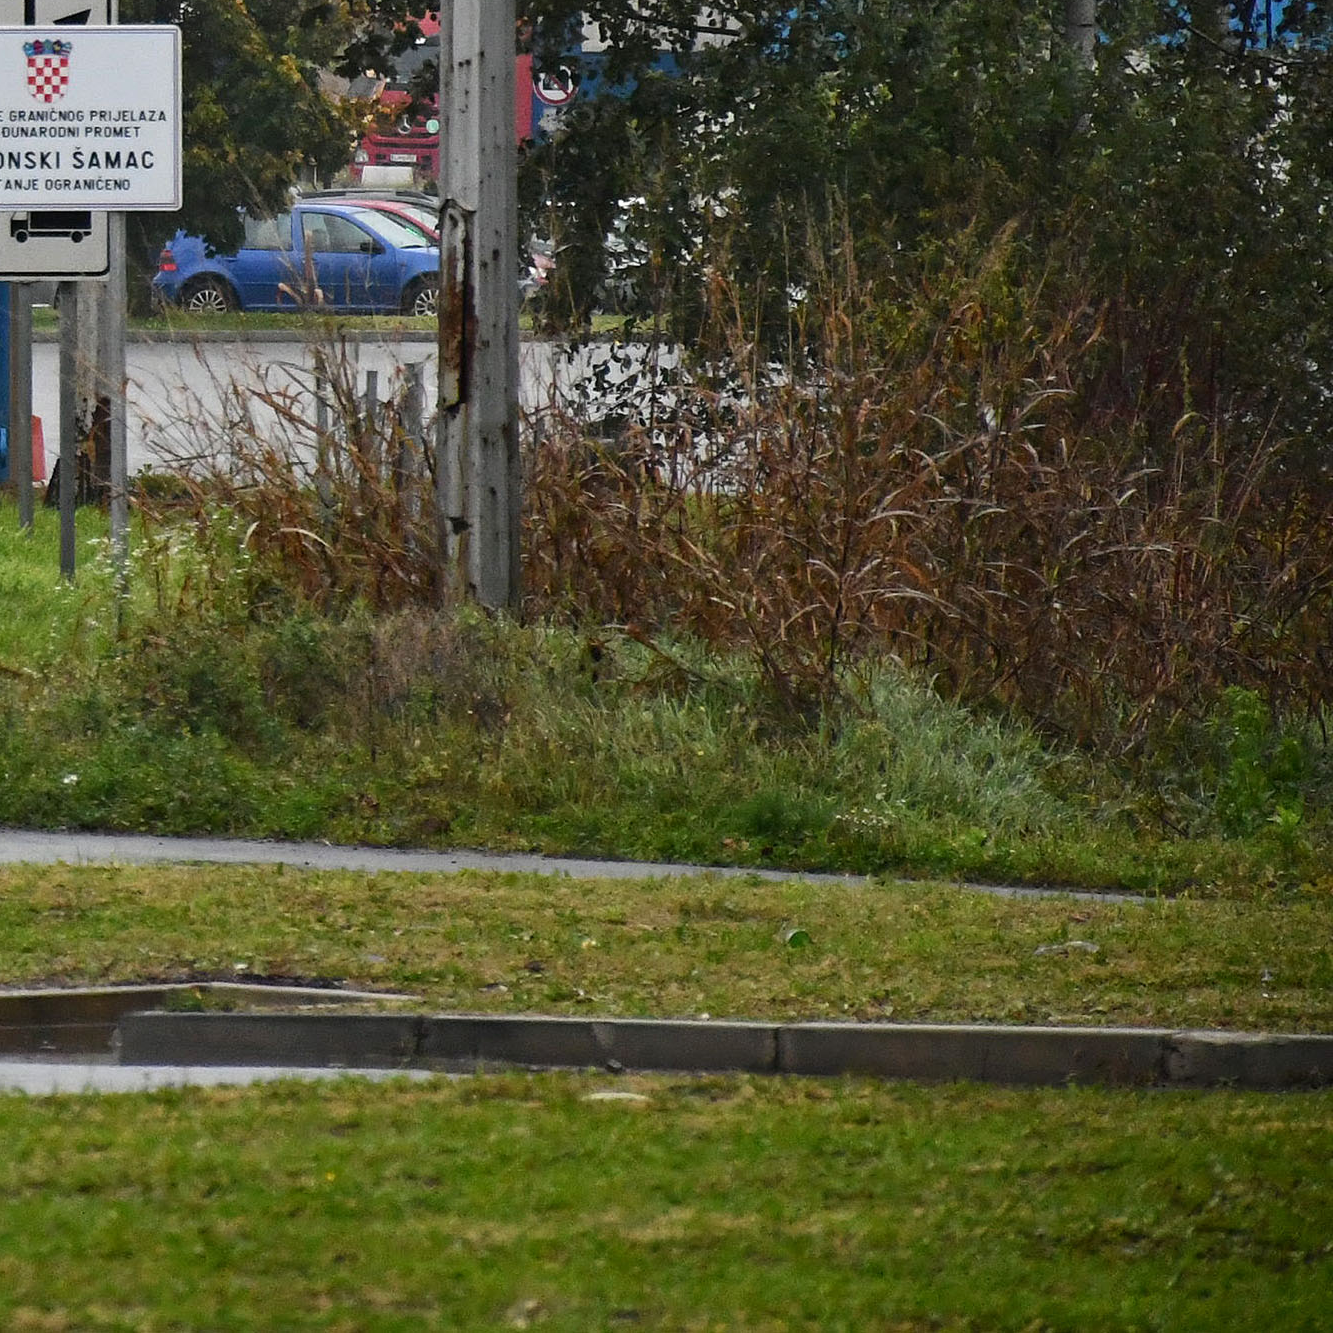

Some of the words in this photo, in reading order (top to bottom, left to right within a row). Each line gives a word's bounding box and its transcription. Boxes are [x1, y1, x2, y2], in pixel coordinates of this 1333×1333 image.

[9, 107, 84, 122] GRANIČNOG
[90, 110, 167, 122] PRIJELAZA
[85, 126, 141, 138] PROMET
[72, 147, 155, 170] ŠAMAC
[45, 176, 131, 191] OGRANIČENO
